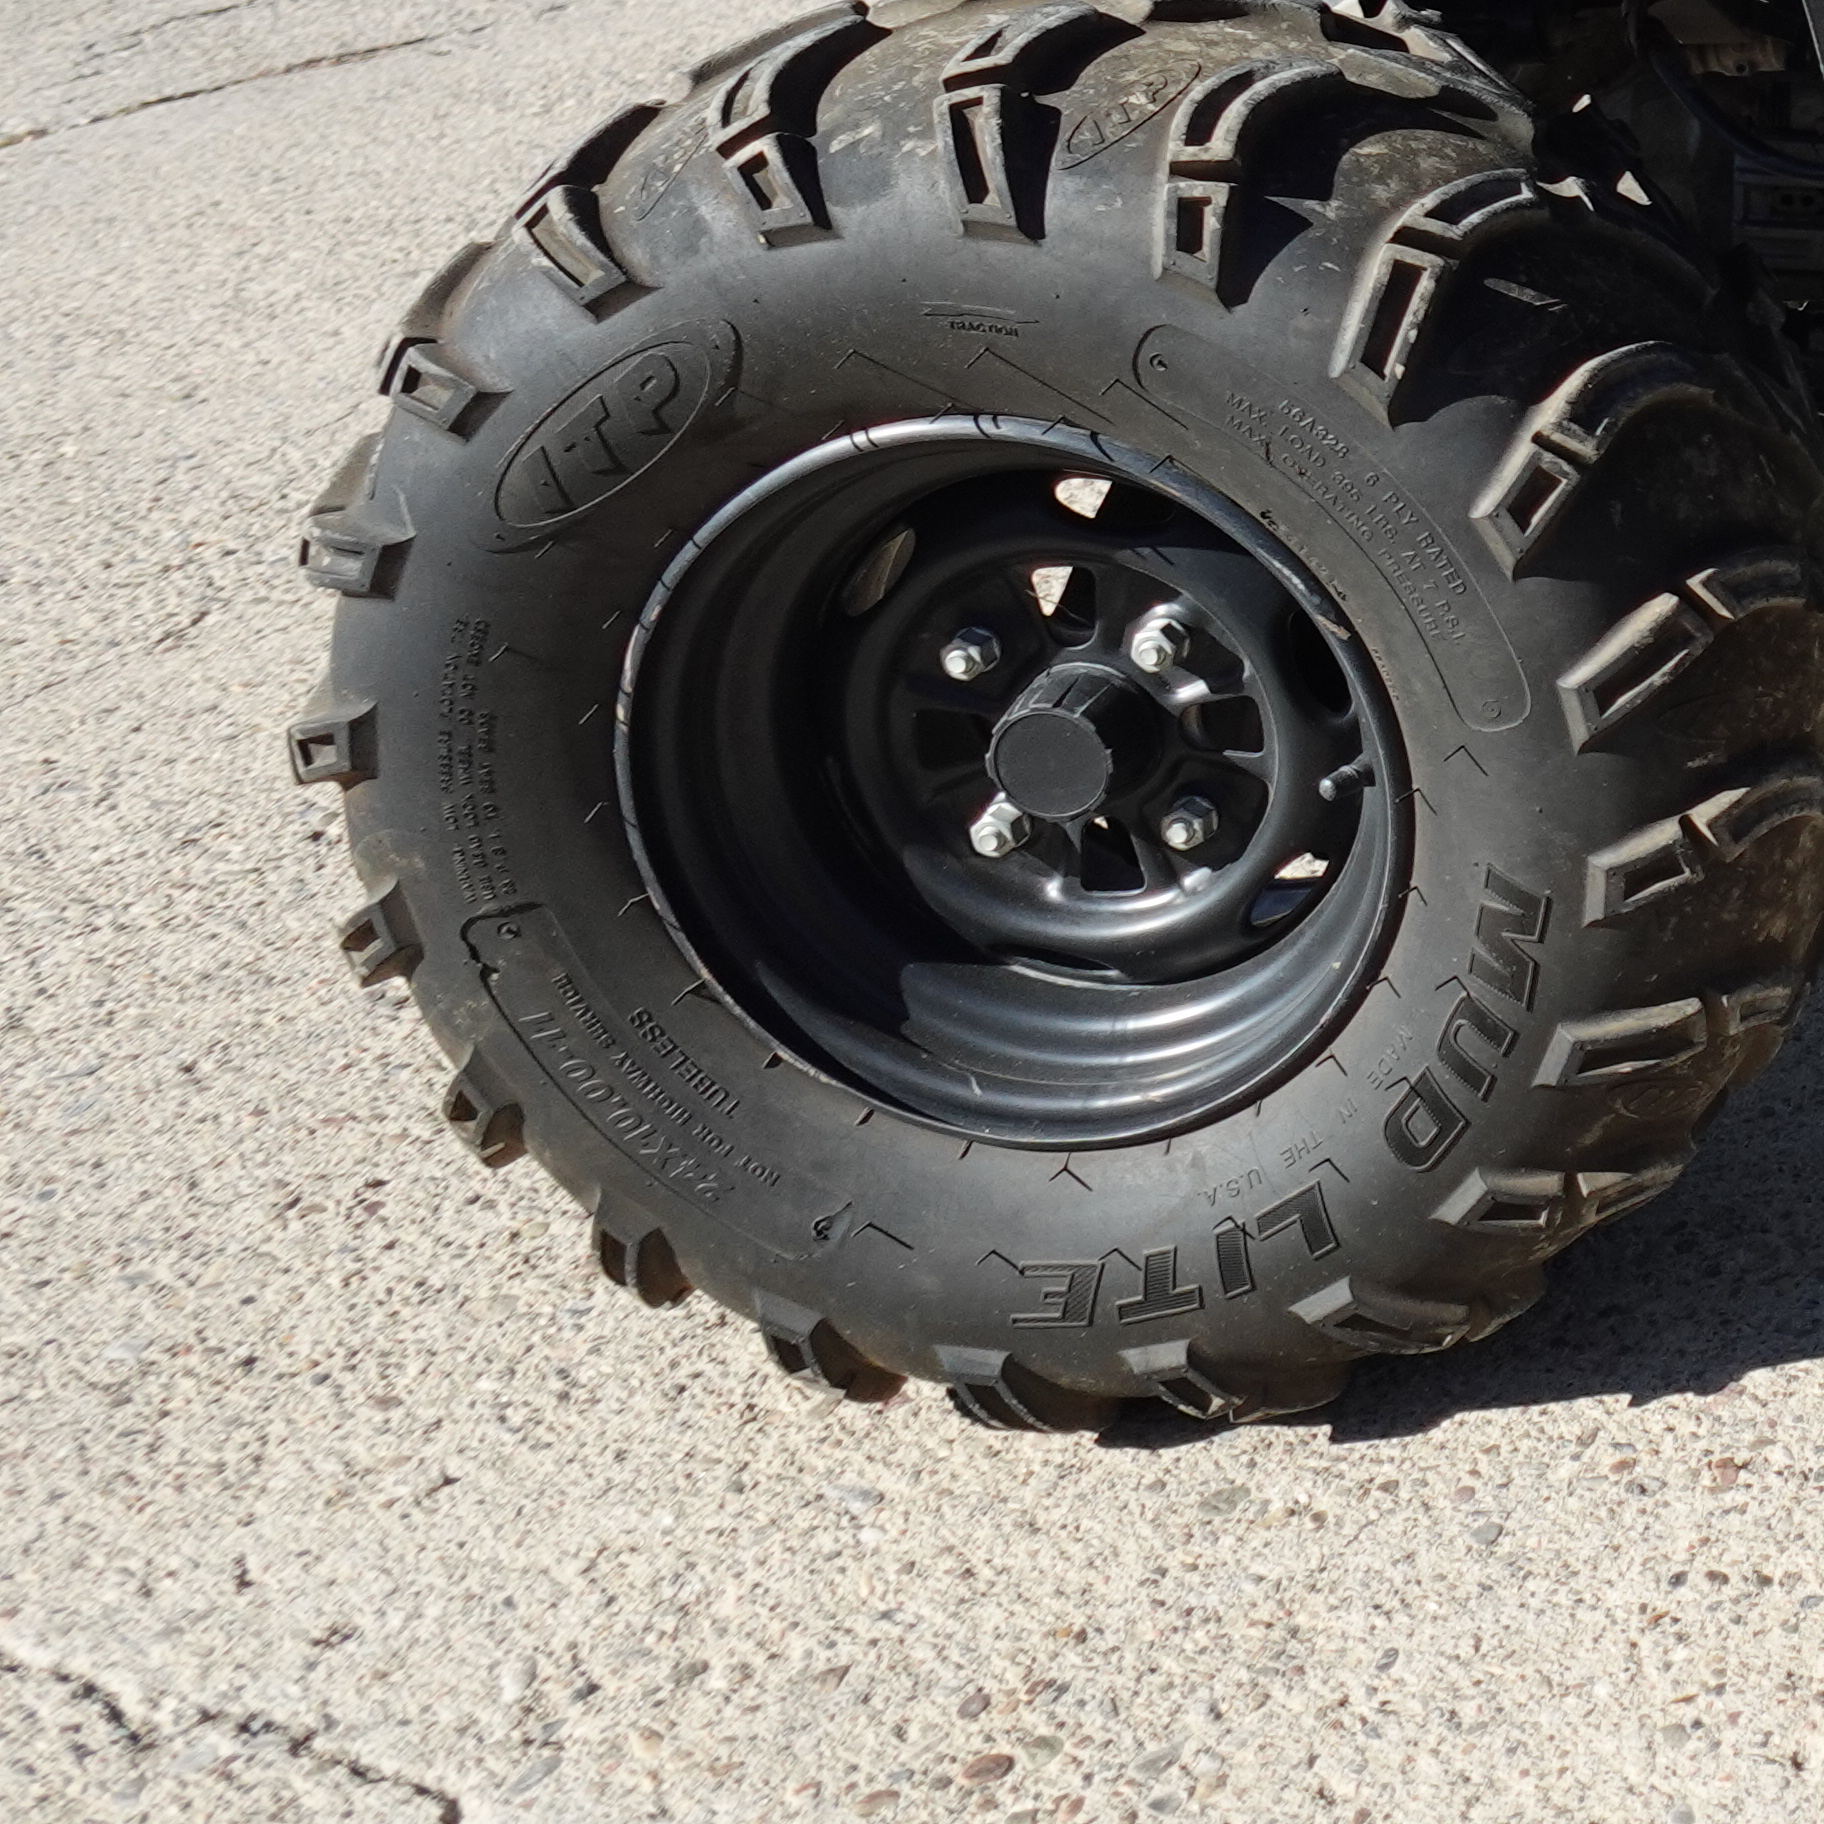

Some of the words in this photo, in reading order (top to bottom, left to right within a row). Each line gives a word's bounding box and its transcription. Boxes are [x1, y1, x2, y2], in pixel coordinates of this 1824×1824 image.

[521, 351, 681, 515] ITP
[1278, 424, 1326, 469] LOAD
[1382, 490, 1419, 526] PLY
[1416, 531, 1468, 597] RATED
[627, 1006, 741, 1120] TUBELESS
[1366, 1024, 1413, 1092] MADE
[1384, 863, 1553, 1174] MUD
[692, 1122, 736, 1158] FOR
[734, 1155, 782, 1188] NOT
[1010, 1180, 1341, 1329] LITE
